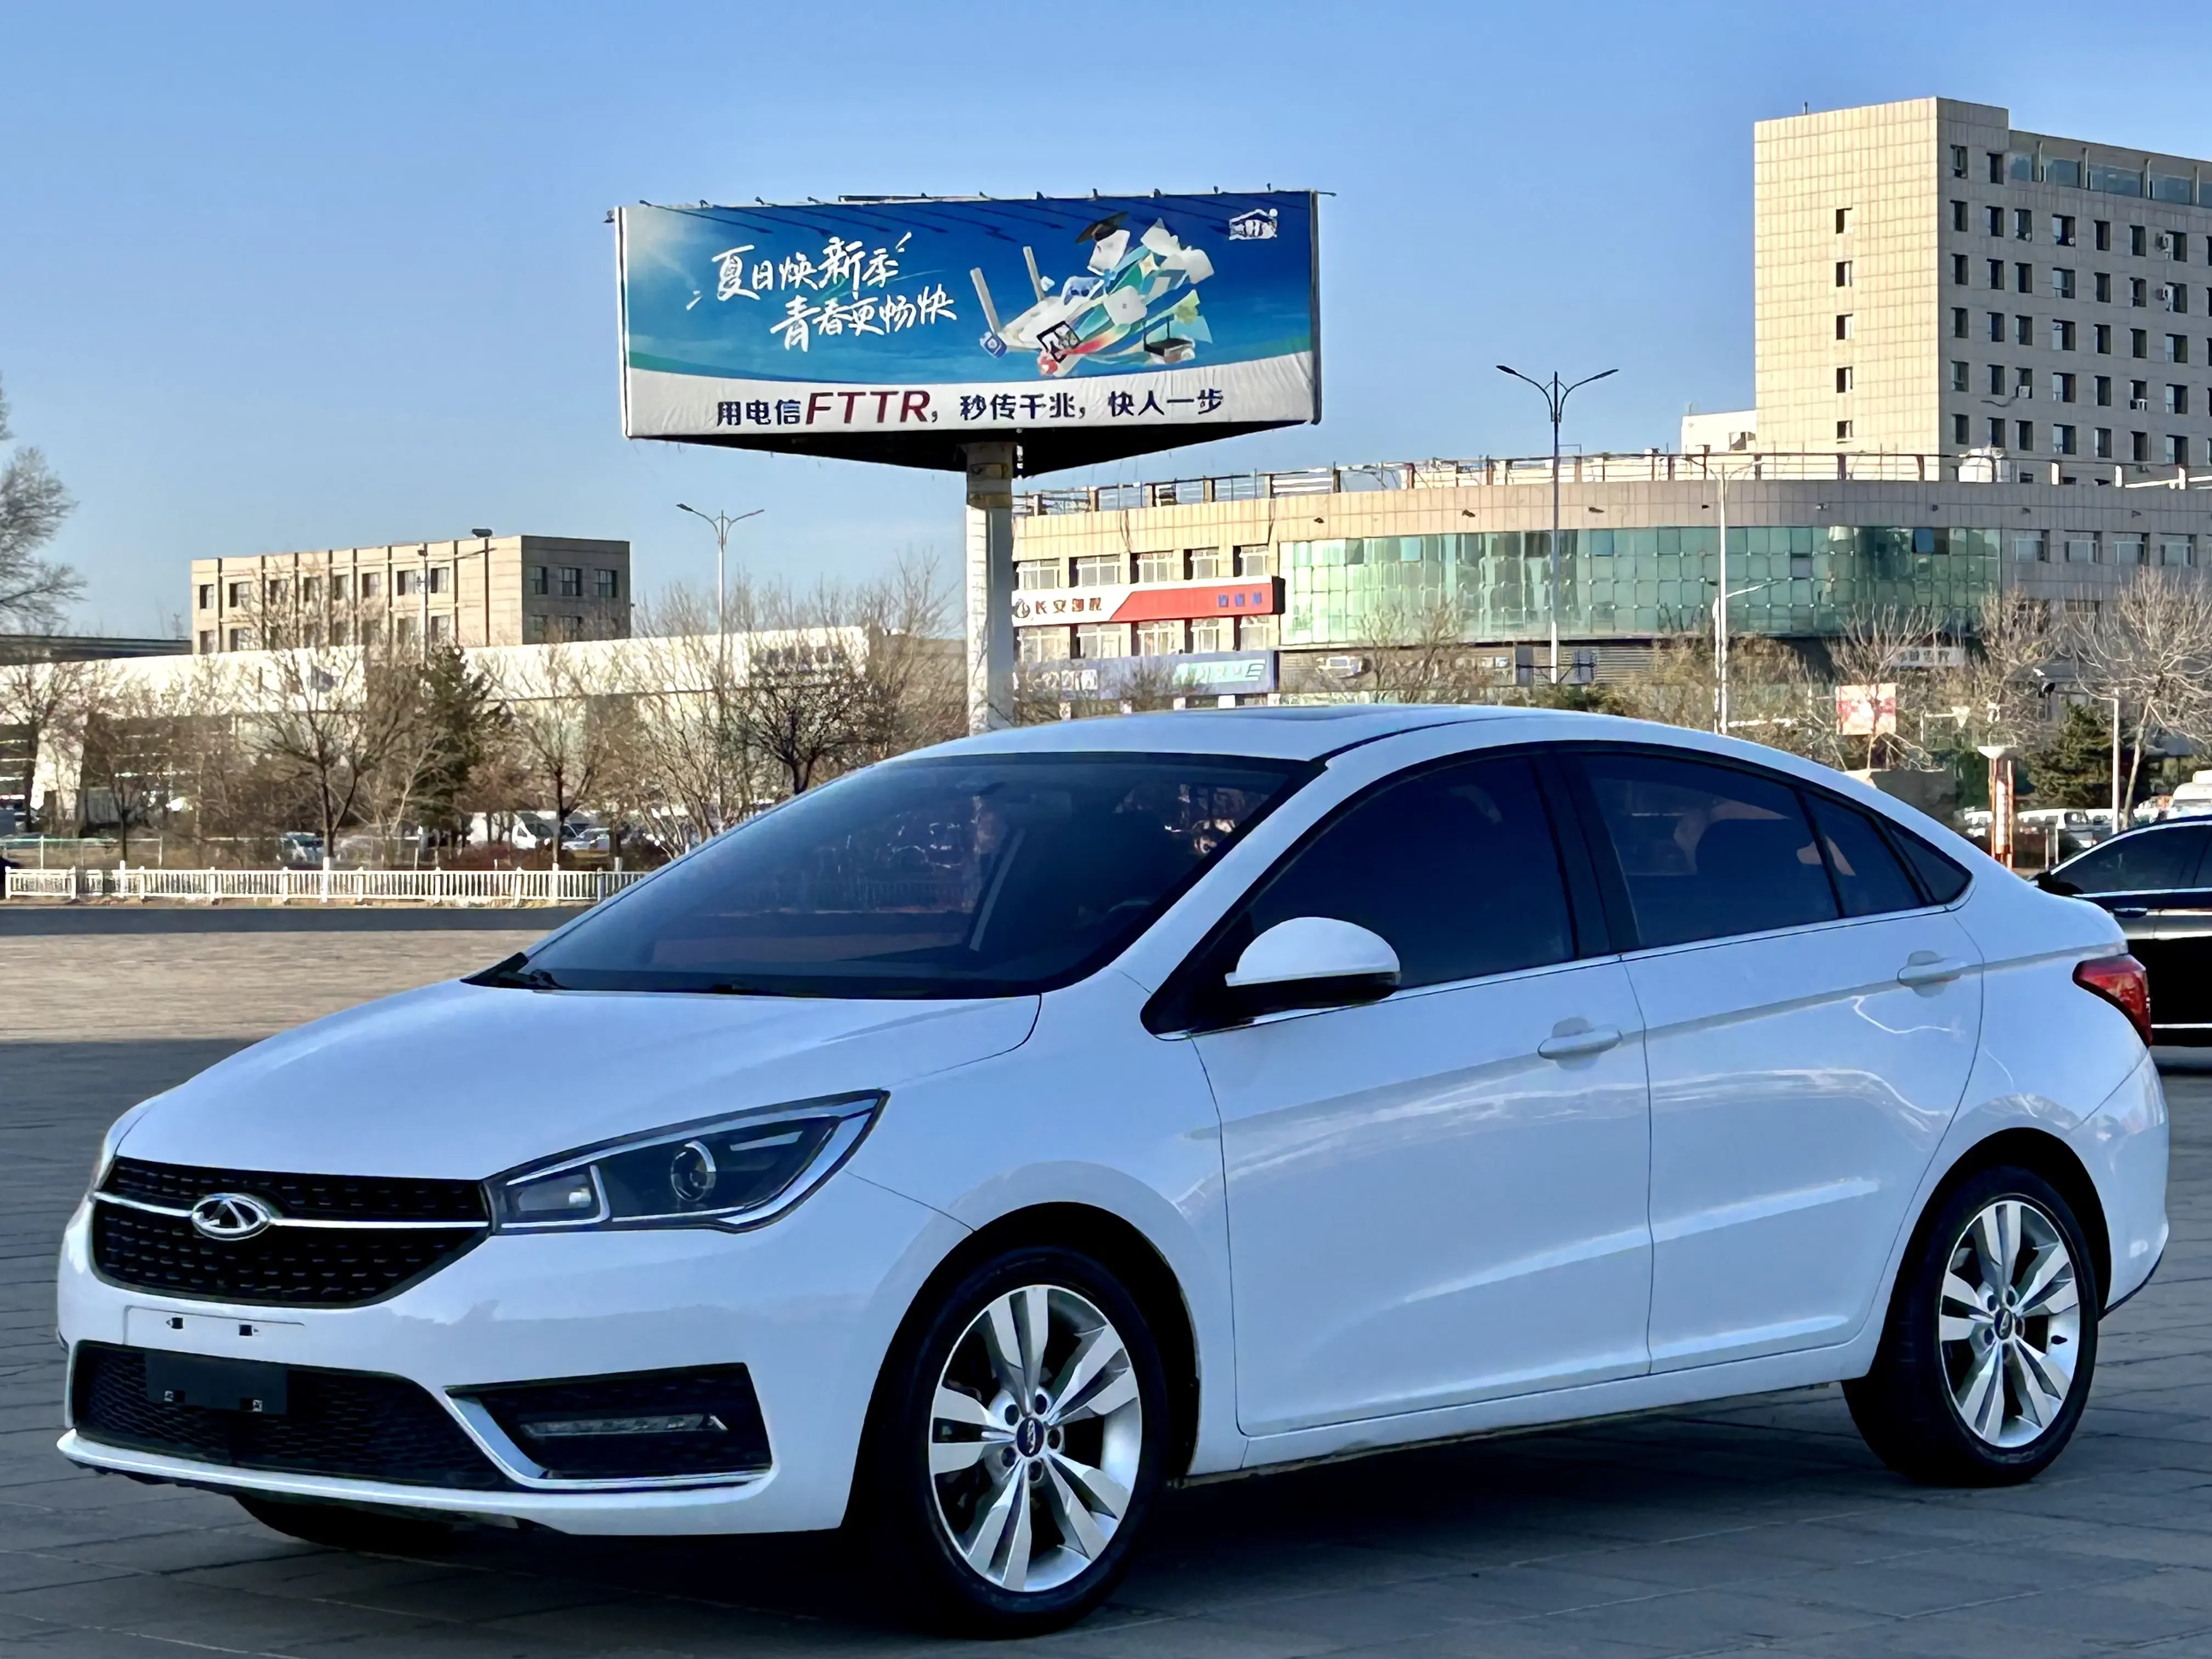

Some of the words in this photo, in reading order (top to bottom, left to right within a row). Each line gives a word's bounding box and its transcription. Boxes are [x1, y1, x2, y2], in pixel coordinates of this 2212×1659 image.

[712, 236, 899, 301] 夏日焕新季
[770, 283, 958, 352] 青春更畅快
